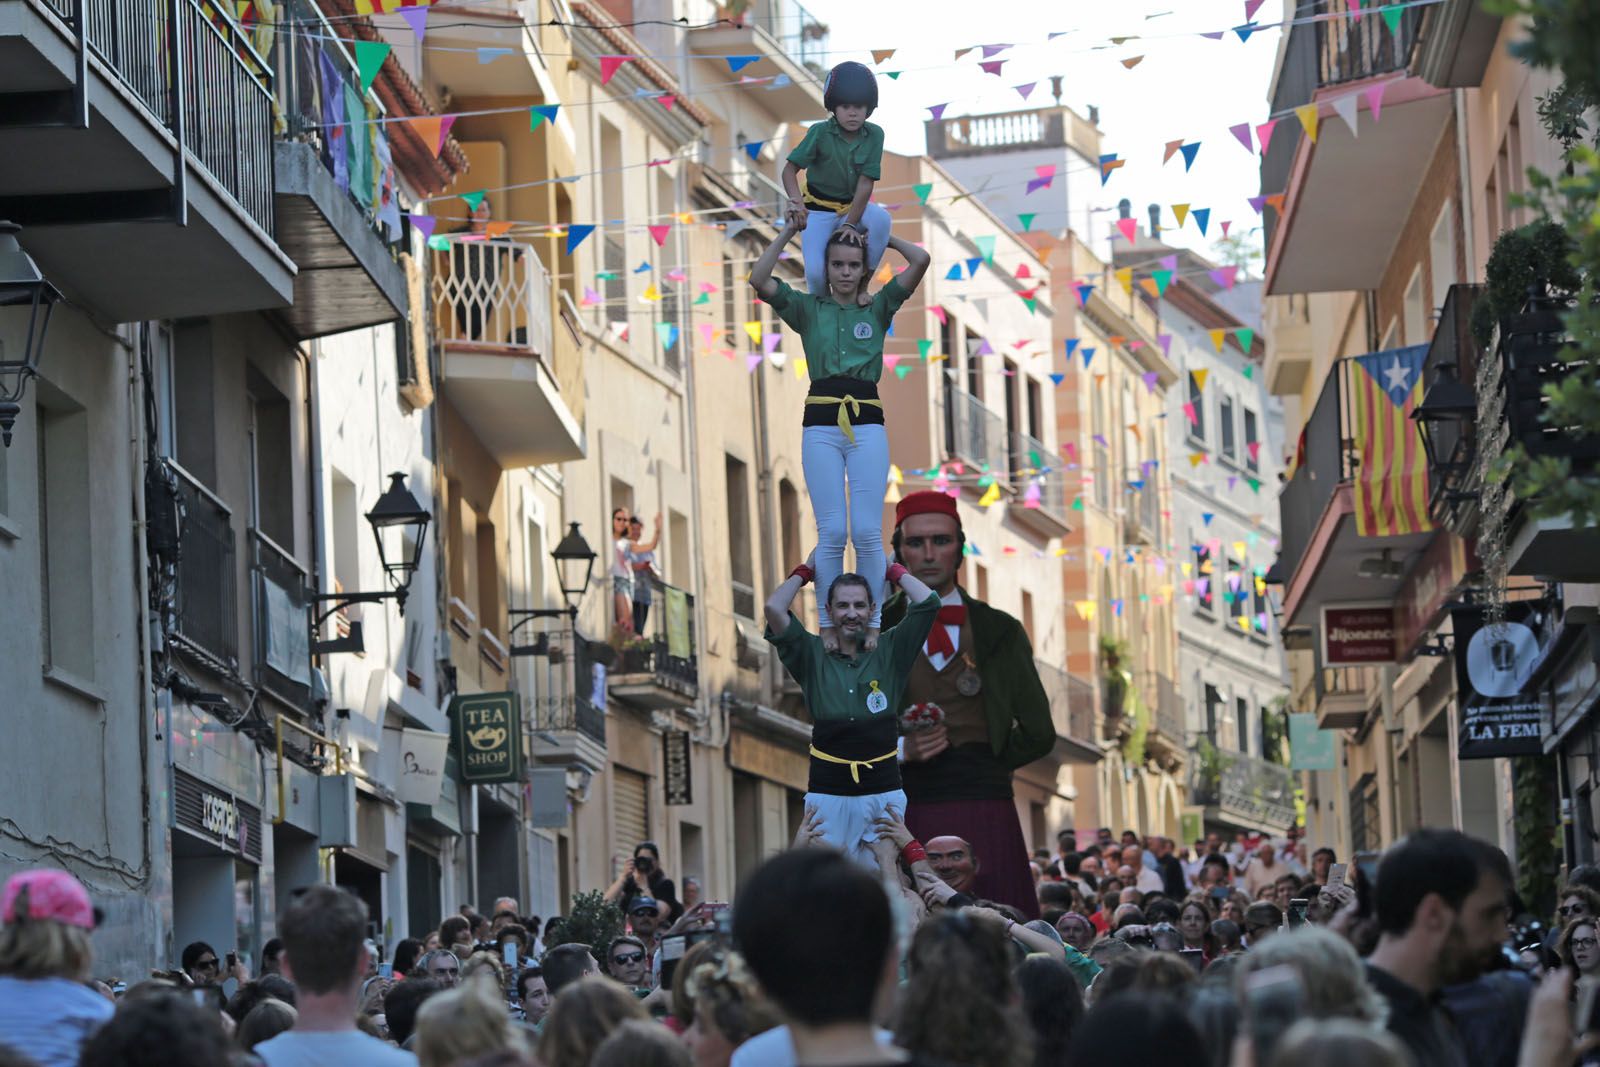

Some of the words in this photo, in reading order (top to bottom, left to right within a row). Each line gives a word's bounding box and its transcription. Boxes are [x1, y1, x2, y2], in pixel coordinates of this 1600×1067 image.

[1329, 627, 1396, 643] Jijonenc
[465, 708, 505, 725] TEA
[1469, 725, 1494, 741] LA
[467, 751, 507, 765] SHOP
